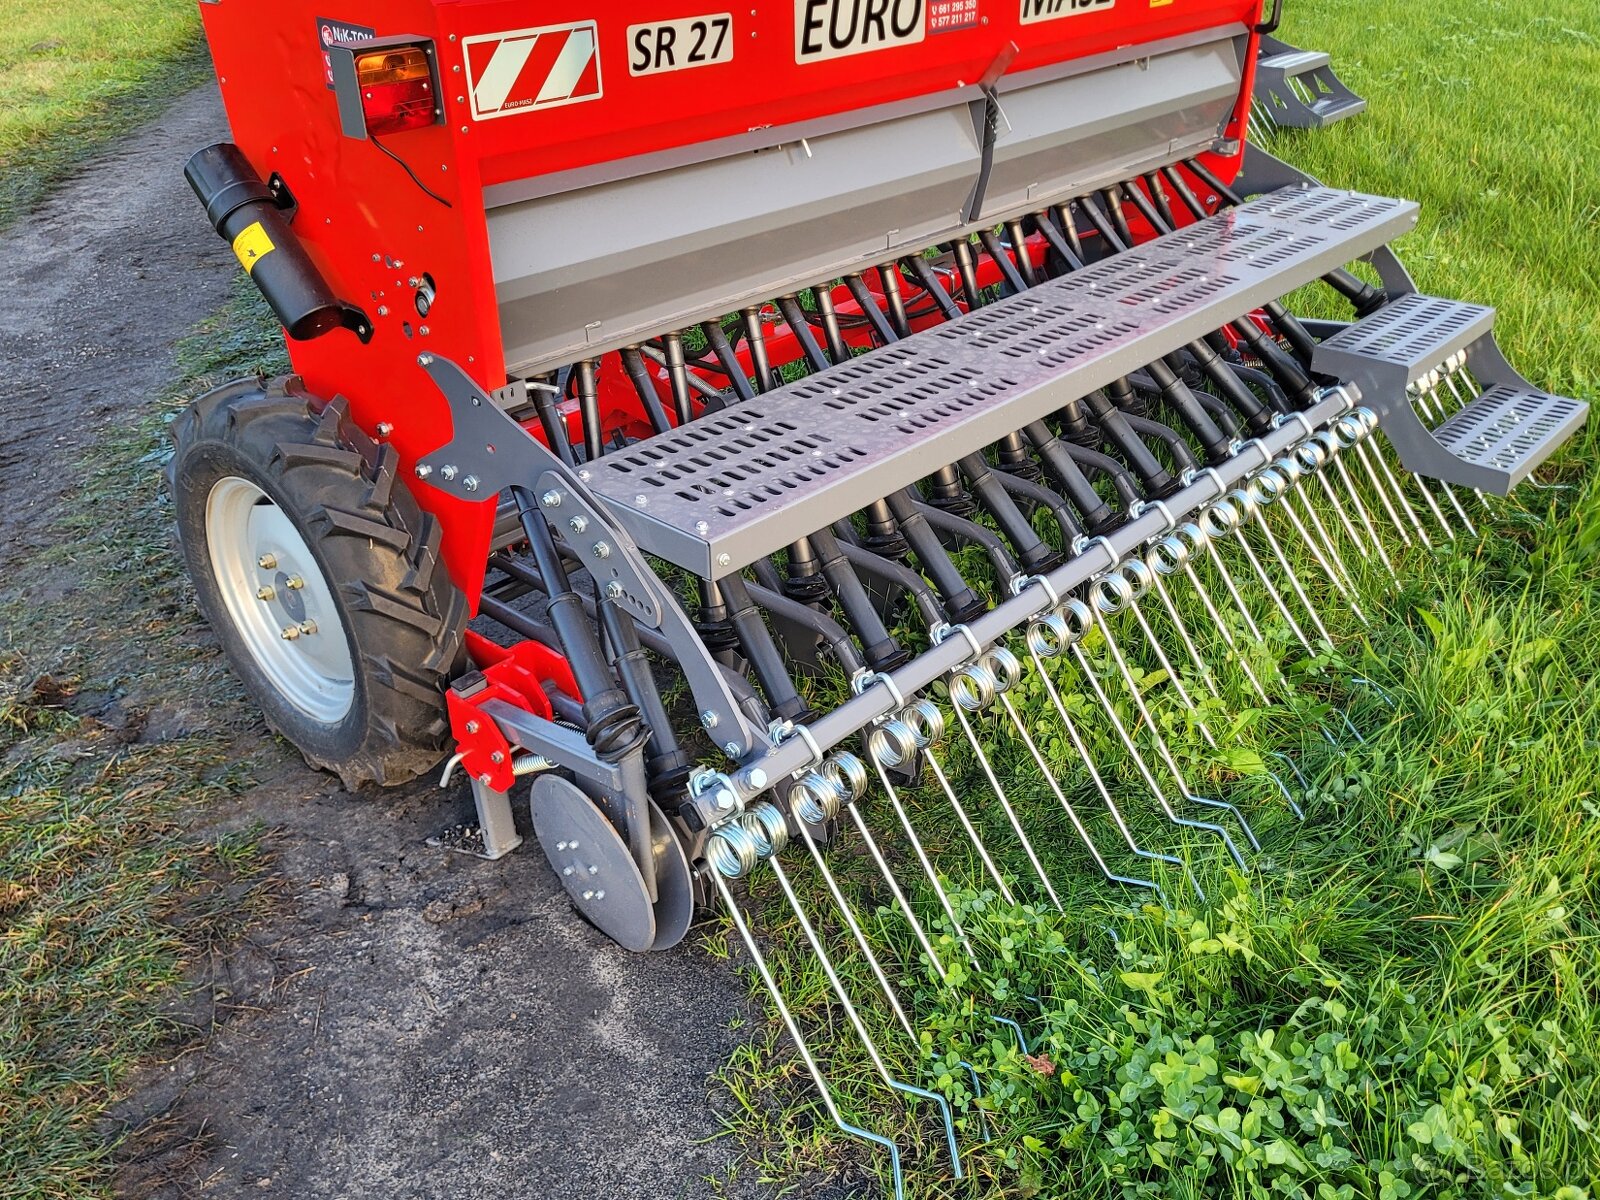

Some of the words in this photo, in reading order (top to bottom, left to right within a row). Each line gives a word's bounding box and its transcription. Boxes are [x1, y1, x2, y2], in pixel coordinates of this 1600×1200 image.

[938, 3, 950, 14] 661
[938, 15, 950, 26] 577
[951, 13, 963, 24] 211
[964, 11, 976, 22] 217
[632, 26, 677, 71] SR
[687, 17, 730, 62] 27
[801, 0, 922, 55] EURO
